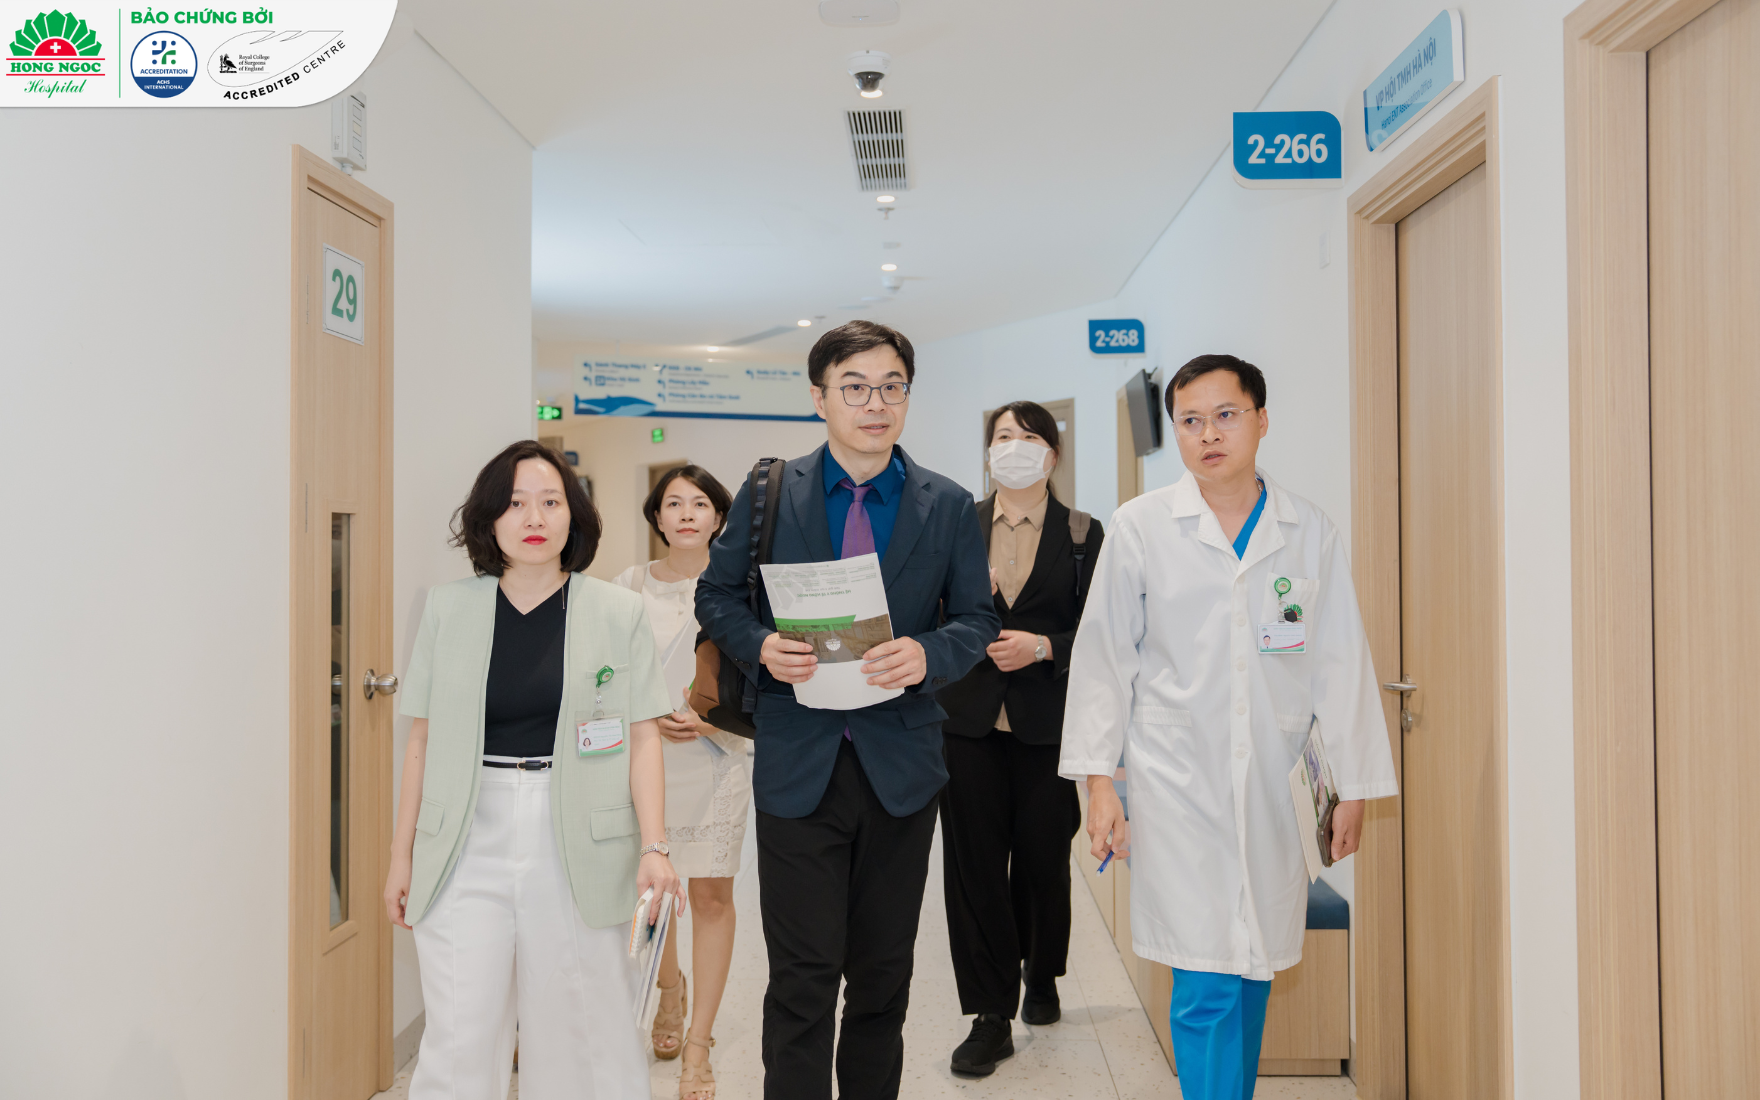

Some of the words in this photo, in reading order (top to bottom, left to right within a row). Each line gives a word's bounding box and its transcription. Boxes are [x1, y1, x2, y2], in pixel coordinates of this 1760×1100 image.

[1375, 90, 1384, 111] VP
[1384, 76, 1396, 103] HỘI
[1396, 62, 1411, 91] TMH
[1412, 49, 1423, 78] HÀ
[1423, 36, 1436, 67] NỘI
[1247, 133, 1328, 164] 2-266
[331, 268, 357, 323] 29
[1094, 328, 1139, 347] 2-268
